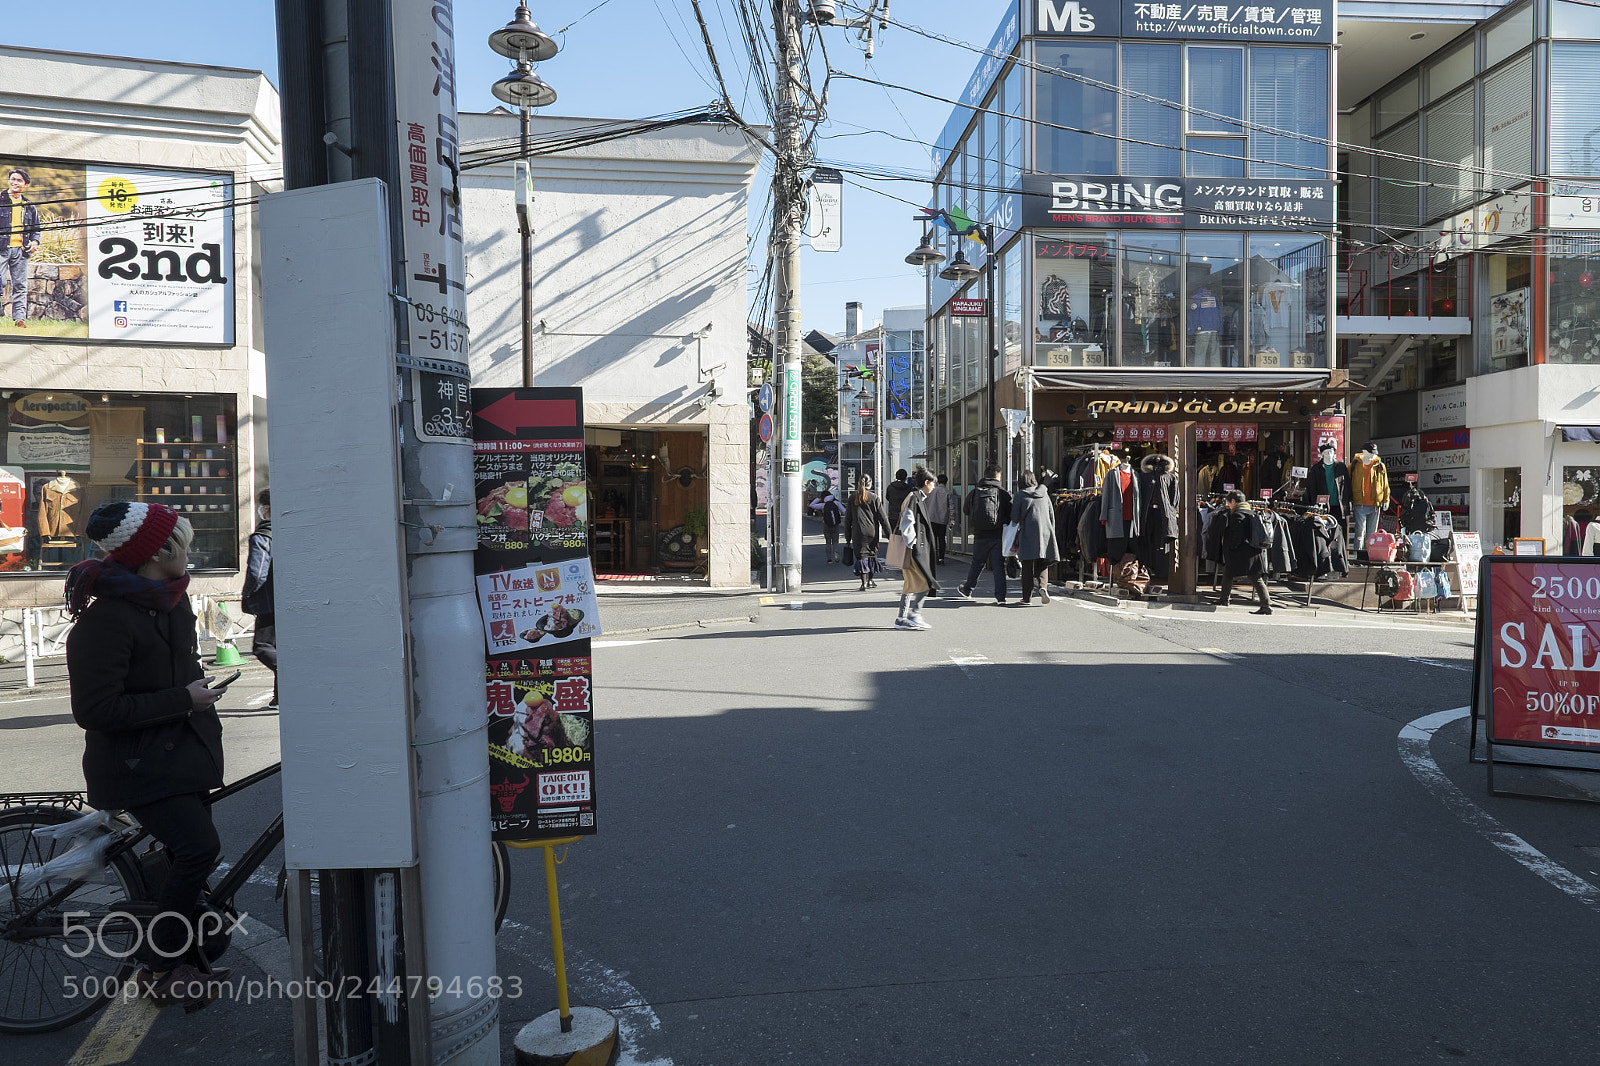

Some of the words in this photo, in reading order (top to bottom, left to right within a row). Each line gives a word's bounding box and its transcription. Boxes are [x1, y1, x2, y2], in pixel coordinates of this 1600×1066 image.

[1136, 20, 1320, 37] http://www.officialtown.com/
[406, 122, 430, 227] 高価買取中
[1051, 181, 1184, 210] BRING
[1194, 185, 1324, 199] メンズブランド買取・販売
[1214, 200, 1304, 212] 高額買取りなら是非
[1052, 213, 1083, 223] MEN'S
[1085, 214, 1120, 224] BRAND
[98, 237, 228, 284] 2nd
[438, 380, 471, 402] 神宮
[22, 400, 87, 413] Aeropostale
[1087, 400, 1179, 414] GRAND
[1183, 400, 1289, 414] GLOBAL
[789, 414, 799, 439] SEED
[530, 453, 582, 461] 当店オリジナル
[1531, 576, 1600, 599] 2500
[1533, 605, 1551, 613] kind
[493, 639, 517, 647] TBS
[541, 746, 591, 766] 1,980円
[541, 774, 566, 783] TAKE
[567, 773, 586, 782] OUT
[542, 783, 586, 796] OK!!
